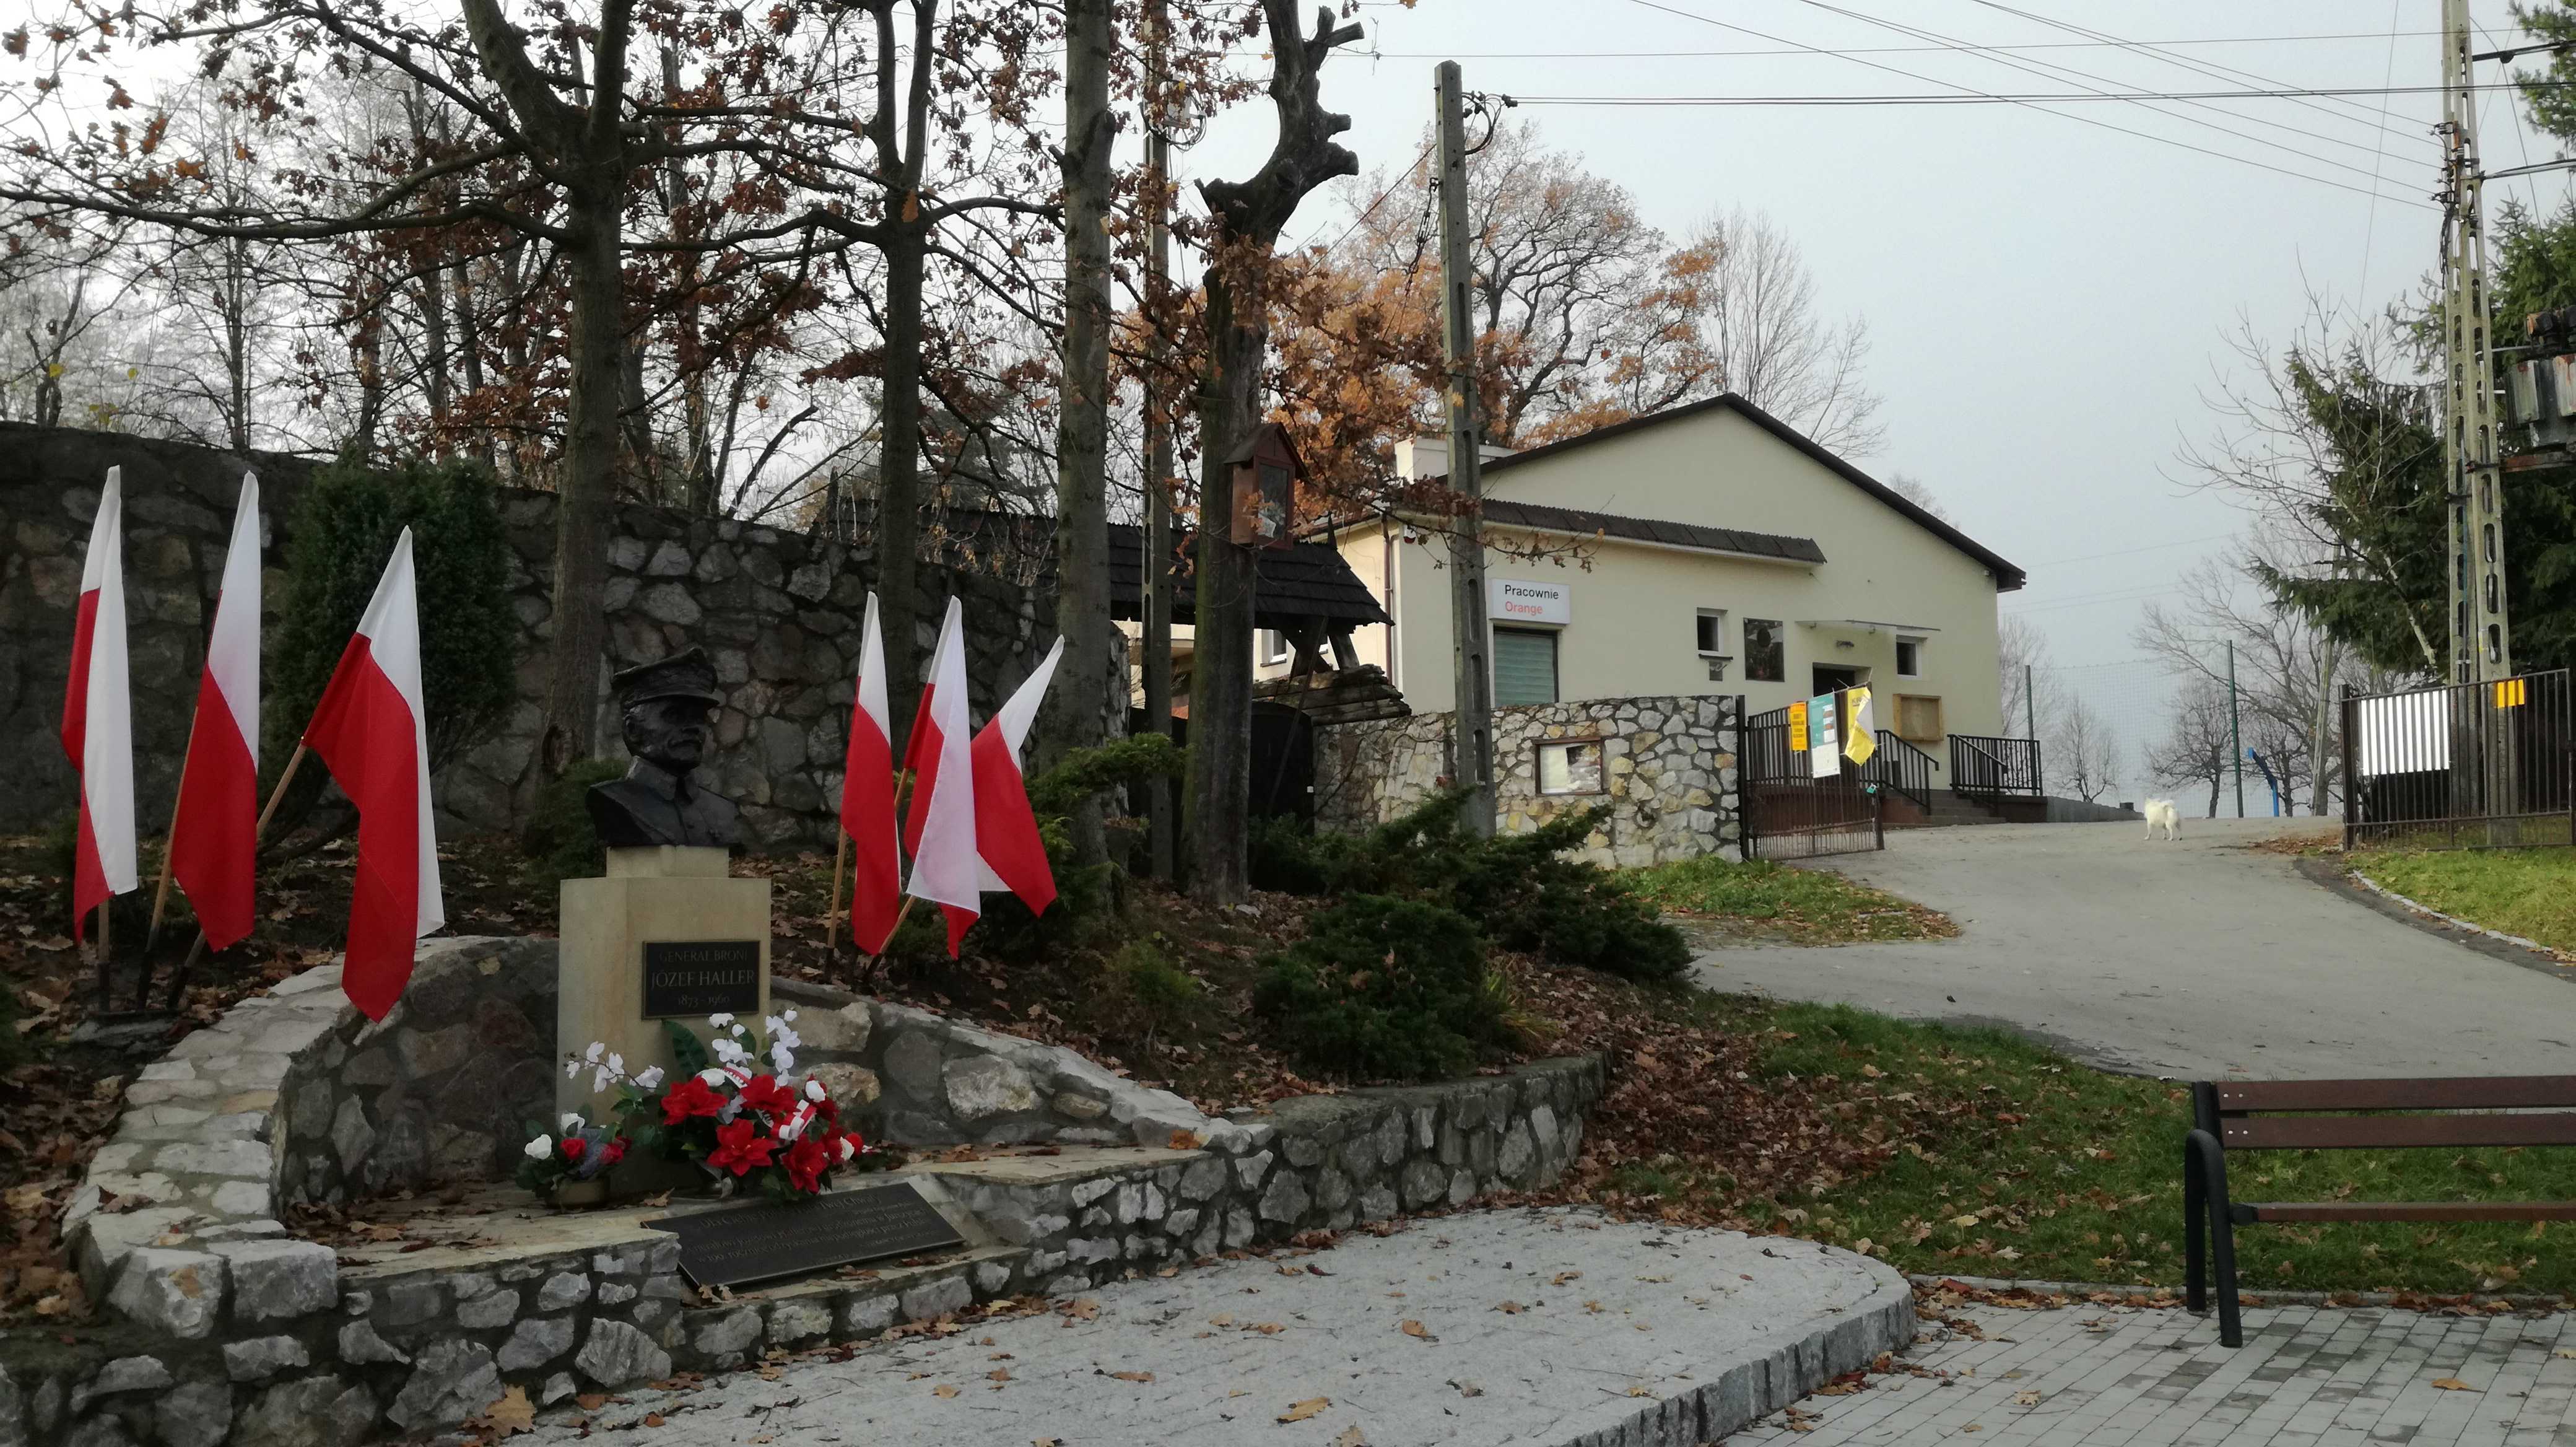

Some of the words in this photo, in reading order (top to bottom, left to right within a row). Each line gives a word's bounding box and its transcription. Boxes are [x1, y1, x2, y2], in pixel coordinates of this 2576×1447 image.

[1505, 584, 1559, 600] Pracownie
[1505, 601, 1543, 616] Orange
[715, 949, 748, 961] BRONI
[651, 970, 695, 990] JÓZEF
[699, 970, 755, 986] HALLER
[679, 994, 698, 1008] 1873
[708, 994, 729, 1007] 1960
